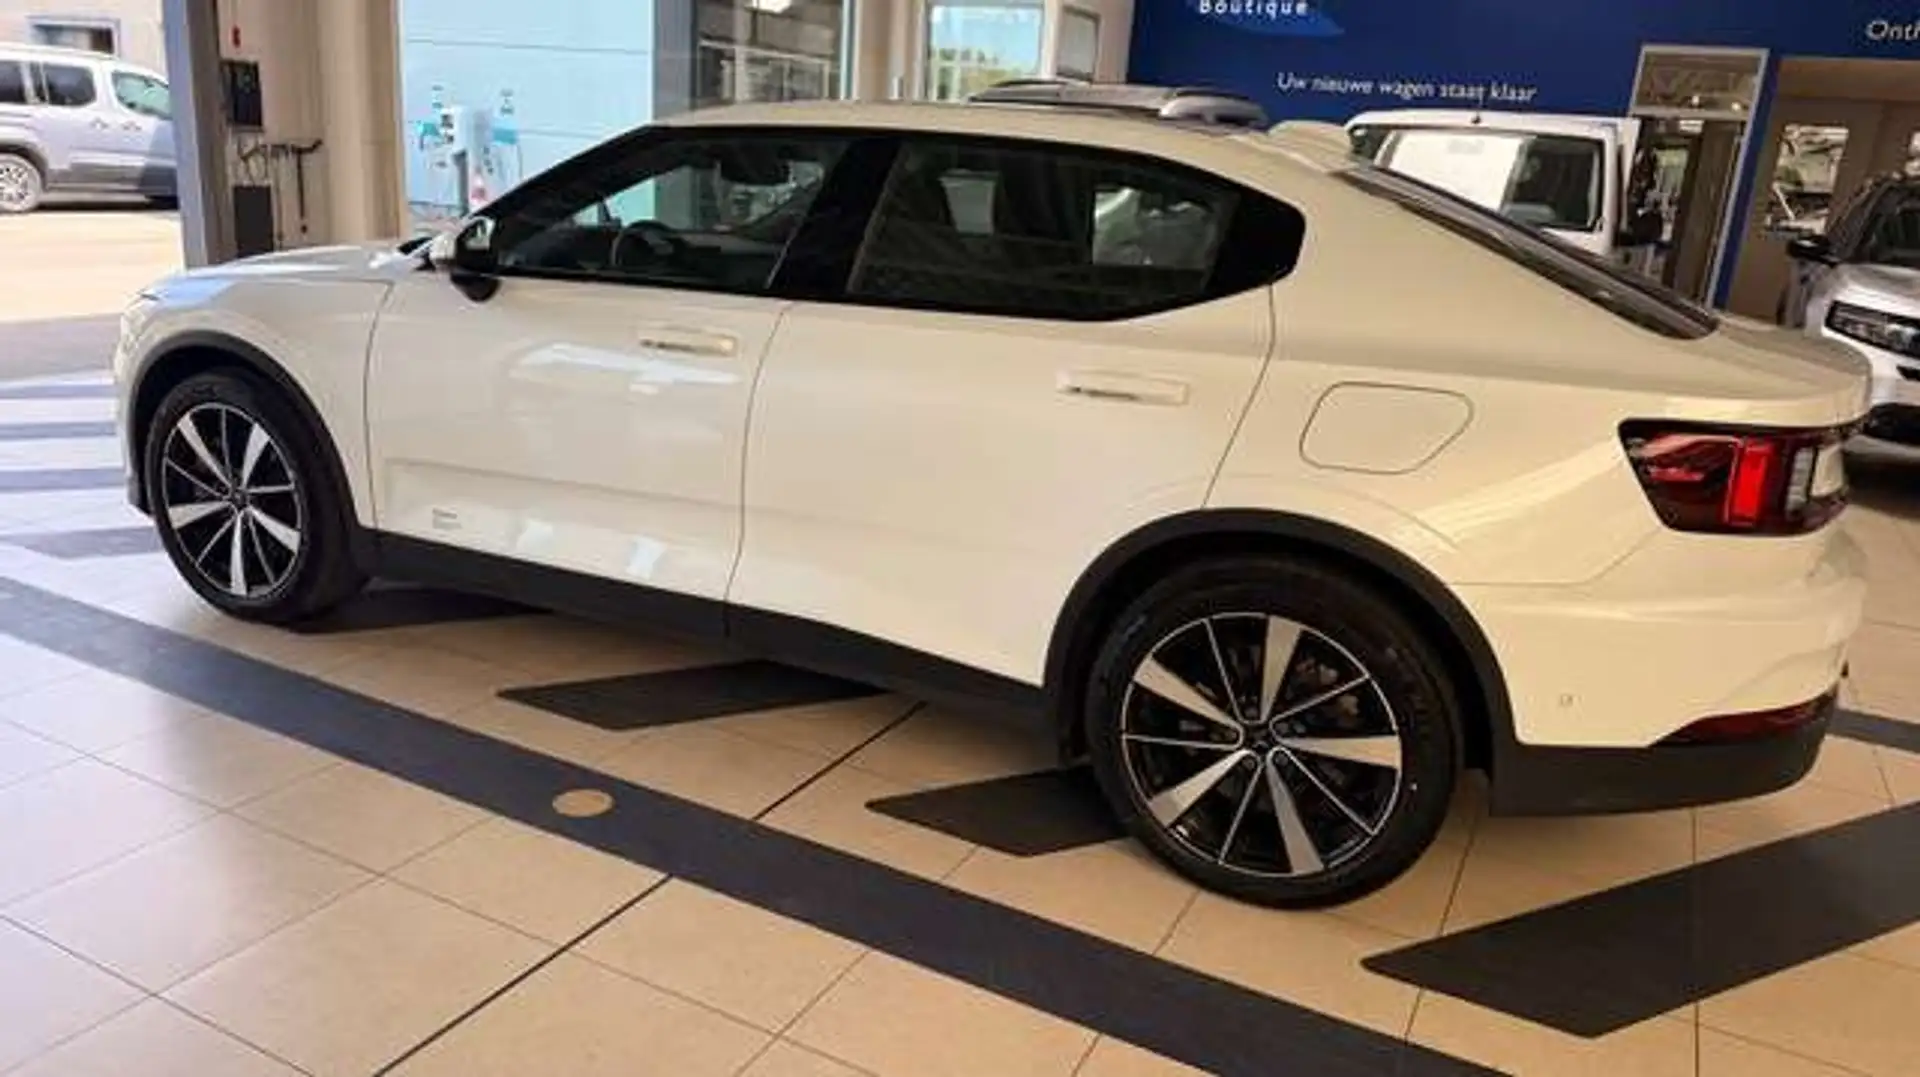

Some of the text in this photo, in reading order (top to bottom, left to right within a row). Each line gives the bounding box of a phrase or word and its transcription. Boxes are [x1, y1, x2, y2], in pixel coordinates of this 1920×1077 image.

[1198, 0, 1308, 20] Boutique
[1277, 72, 1537, 101] Uw nieuwe wagen staat klaar
